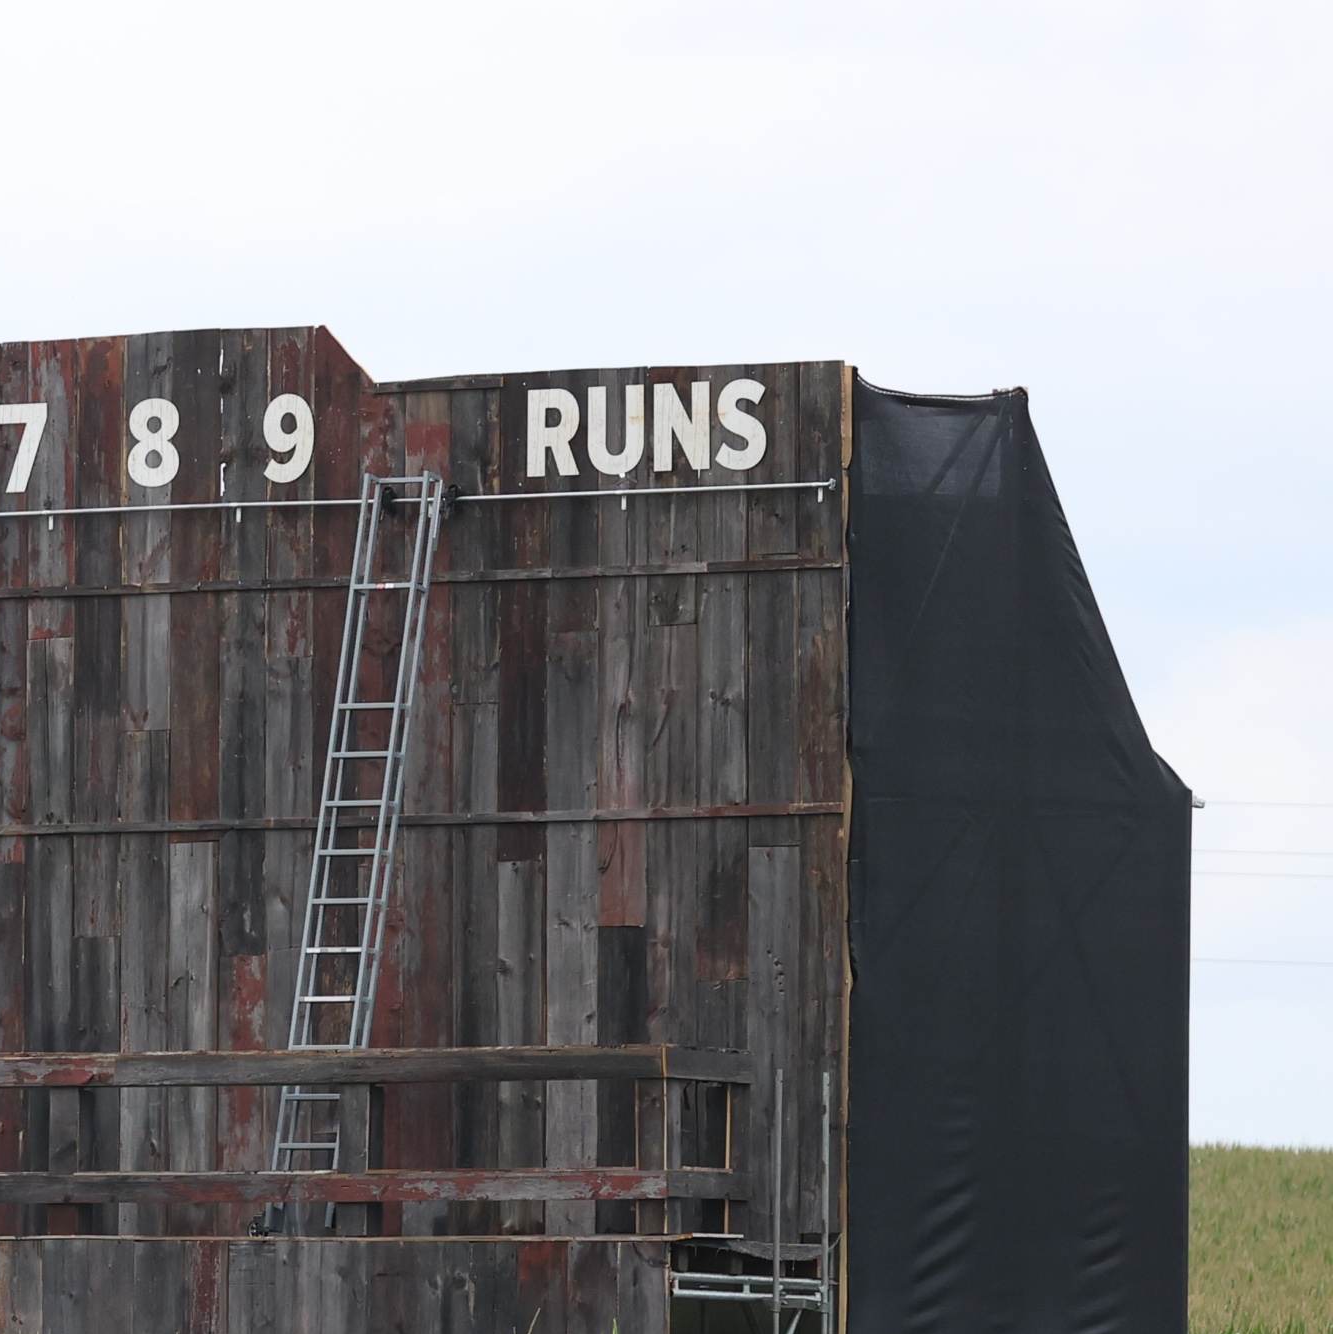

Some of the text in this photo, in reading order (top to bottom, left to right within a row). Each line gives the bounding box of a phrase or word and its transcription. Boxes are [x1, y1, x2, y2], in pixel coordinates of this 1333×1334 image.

[126, 397, 180, 488] 8
[262, 393, 315, 484] 9
[526, 378, 768, 478] RUNS
